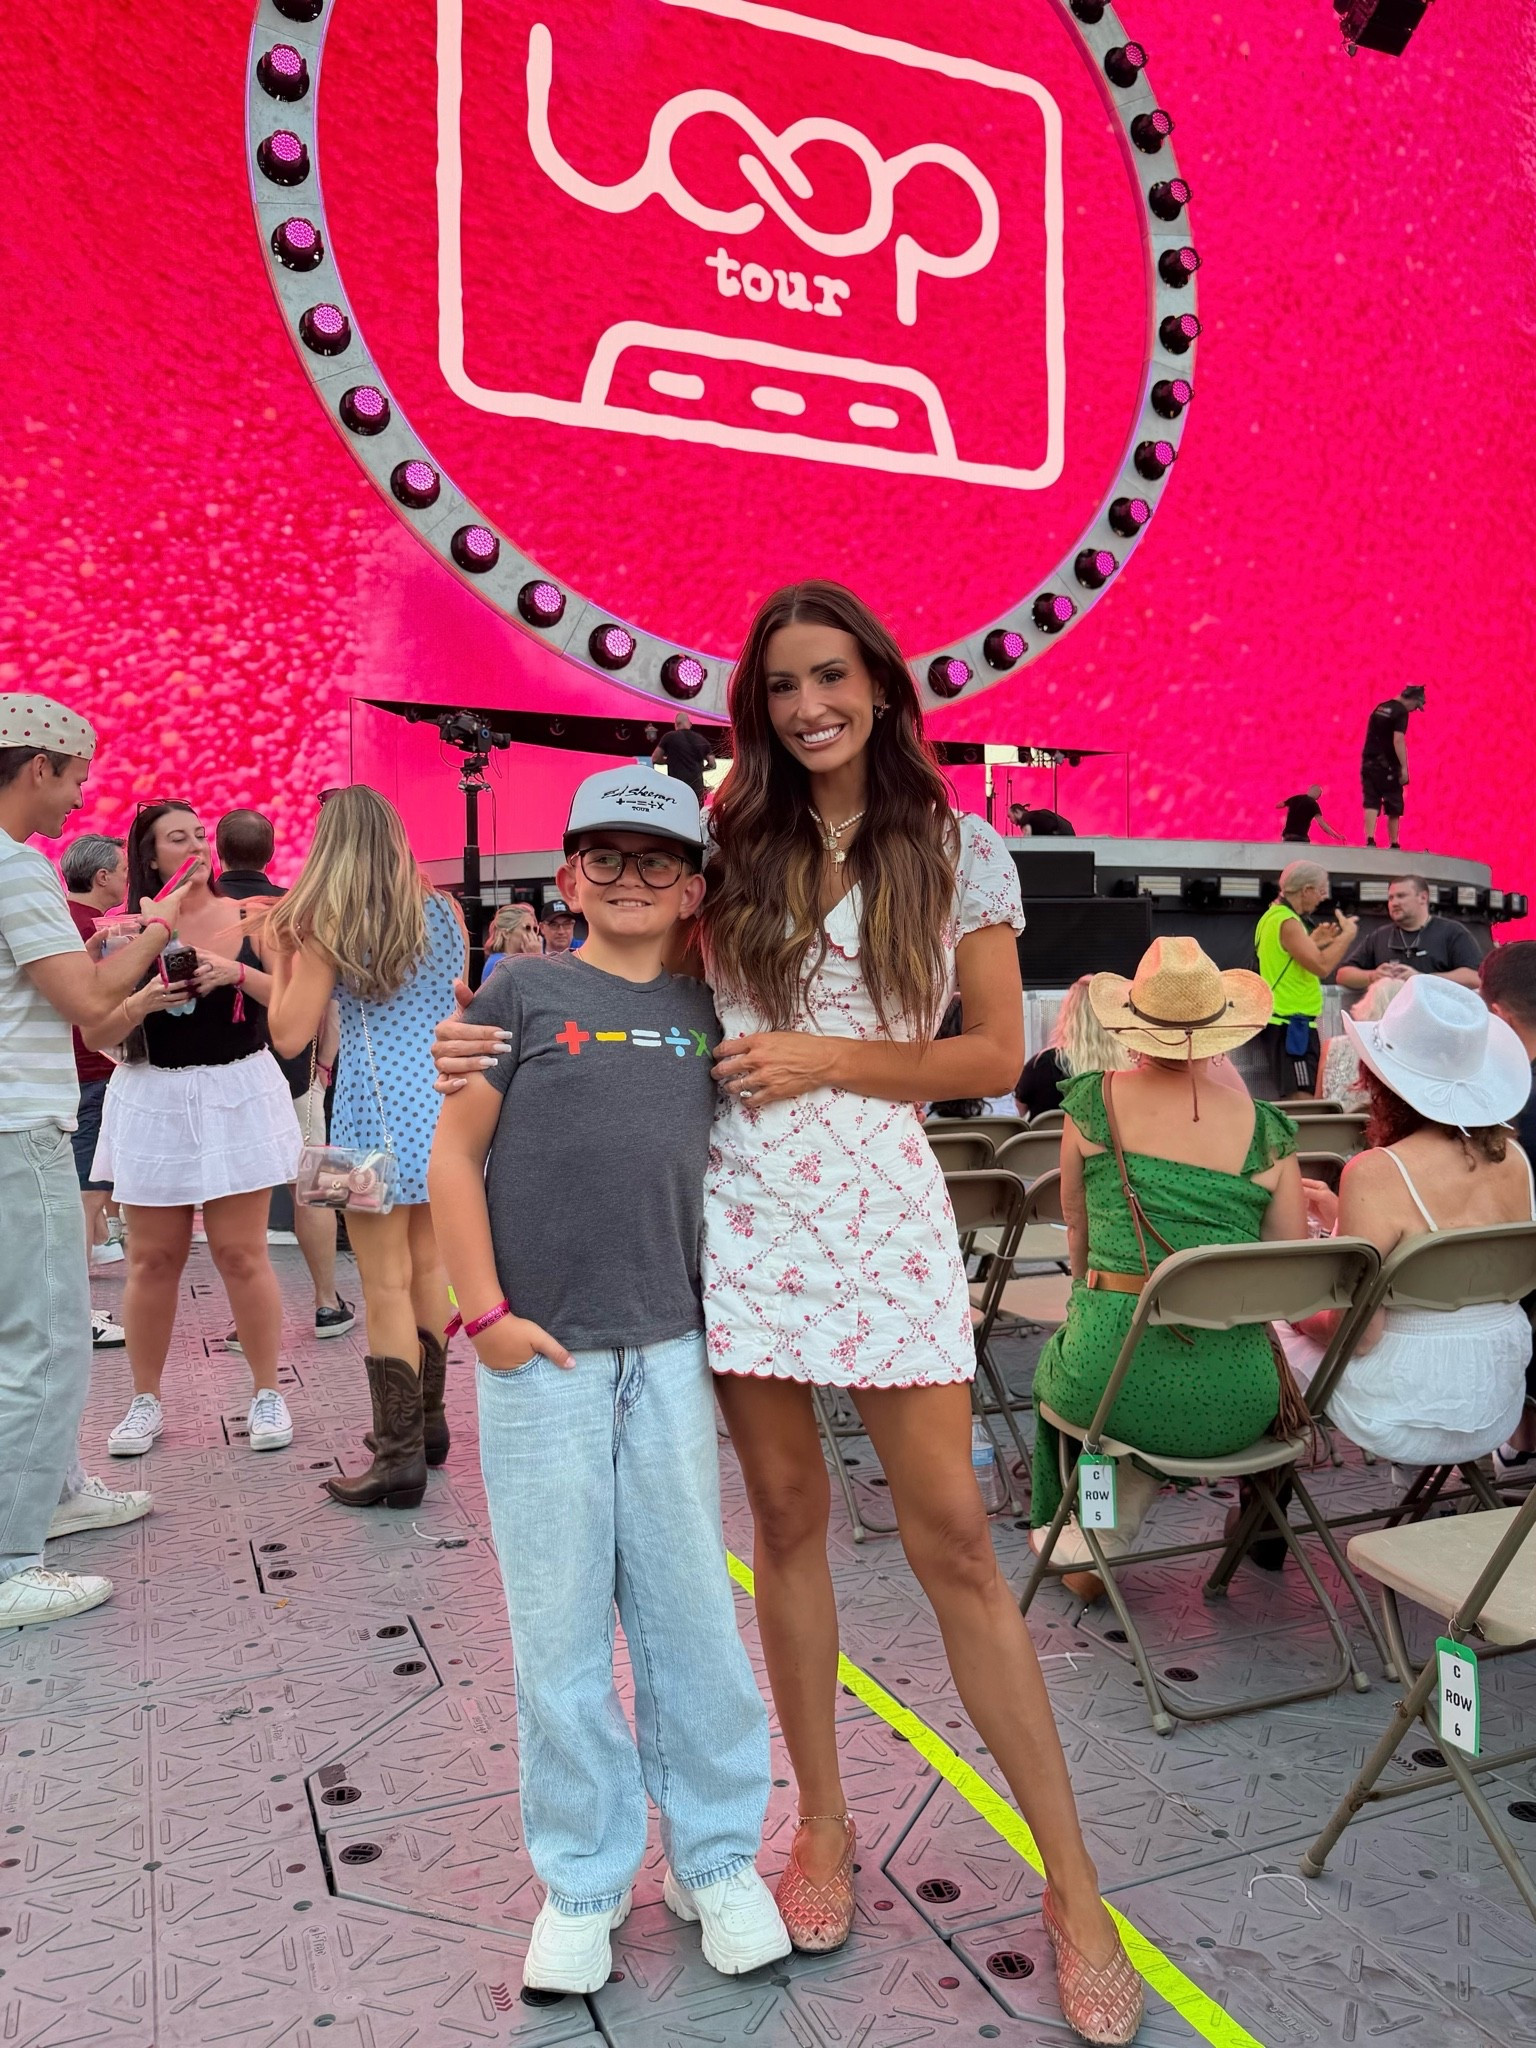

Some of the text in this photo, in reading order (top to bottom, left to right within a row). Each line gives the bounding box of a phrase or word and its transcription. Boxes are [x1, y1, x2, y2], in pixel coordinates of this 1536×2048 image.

[705, 246, 851, 317] tour
[625, 785, 677, 804] Sheeran
[476, 1309, 509, 1332] NISSAN
[478, 1306, 502, 1324] STADIUM
[1093, 1471, 1100, 1480] C
[1085, 1490, 1110, 1500] ROW
[1095, 1511, 1102, 1521] 5
[1453, 1665, 1461, 1679] C
[1445, 1688, 1473, 1712] ROW
[1454, 1723, 1461, 1737] 6
